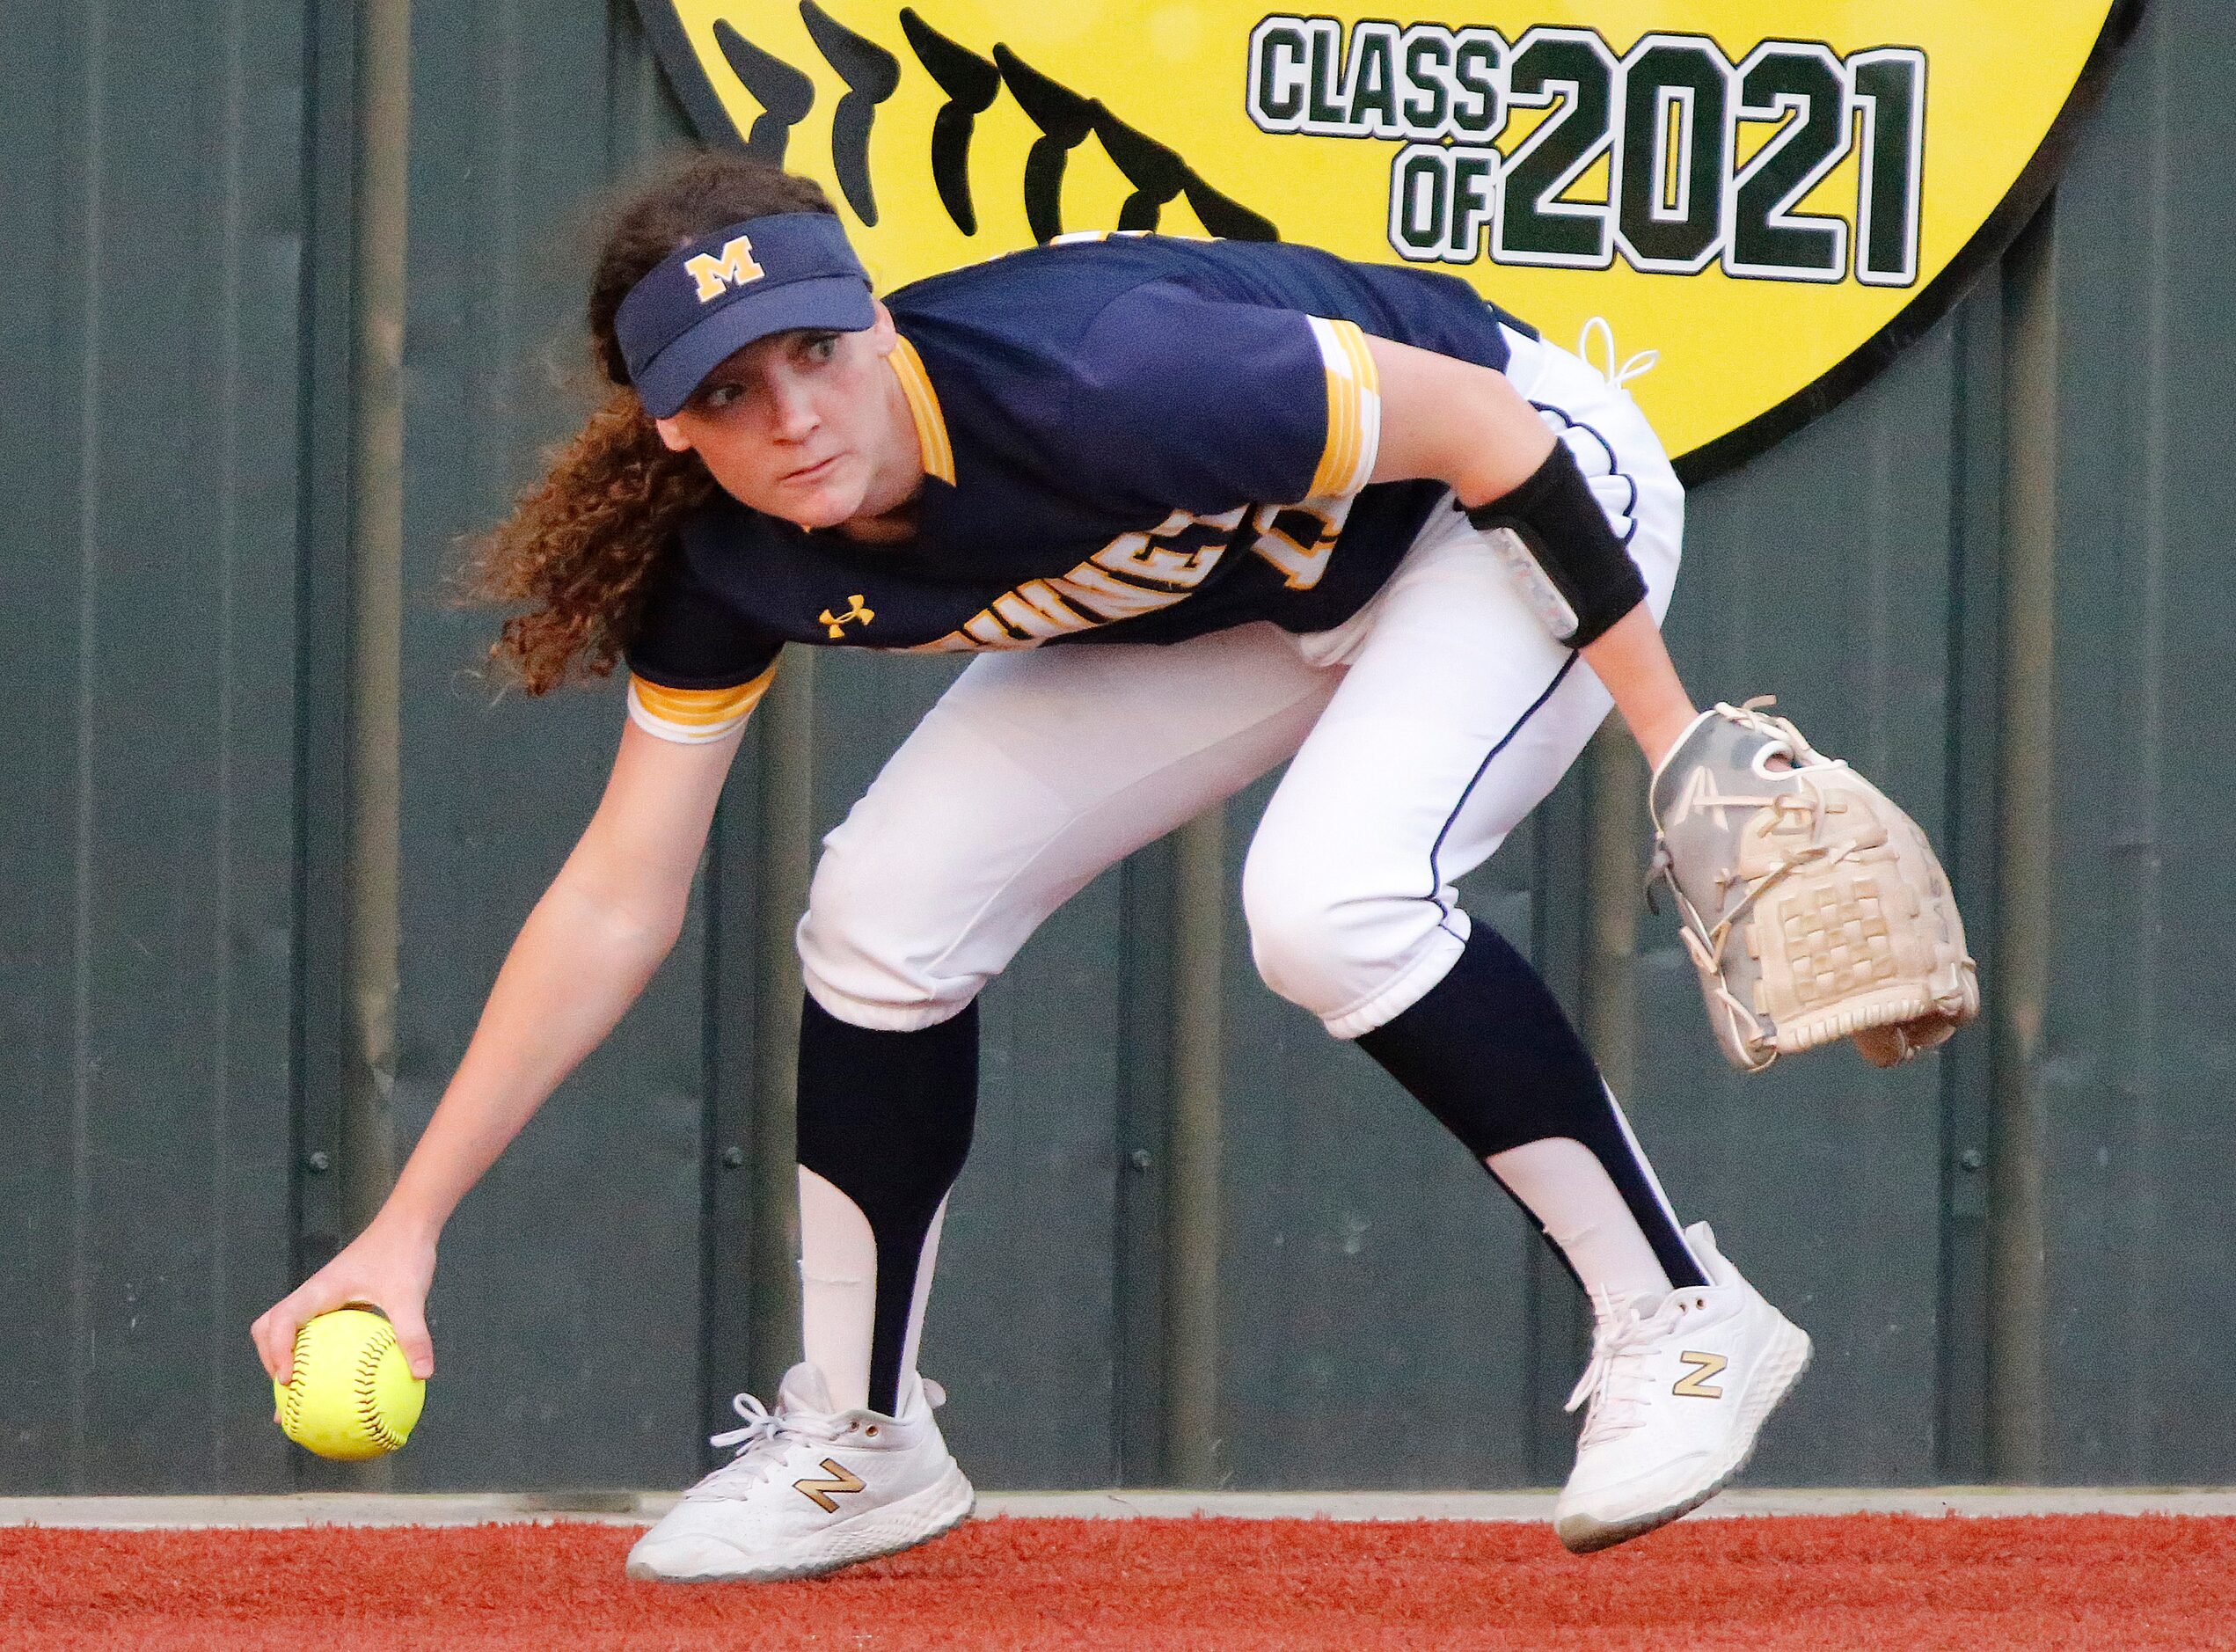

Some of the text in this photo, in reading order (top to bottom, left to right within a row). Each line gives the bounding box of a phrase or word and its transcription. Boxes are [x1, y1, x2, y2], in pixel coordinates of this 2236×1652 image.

[1248, 15, 1506, 141] CLASS
[1390, 143, 1502, 262] OF
[1491, 25, 1928, 286] 2021
[683, 234, 765, 303] M
